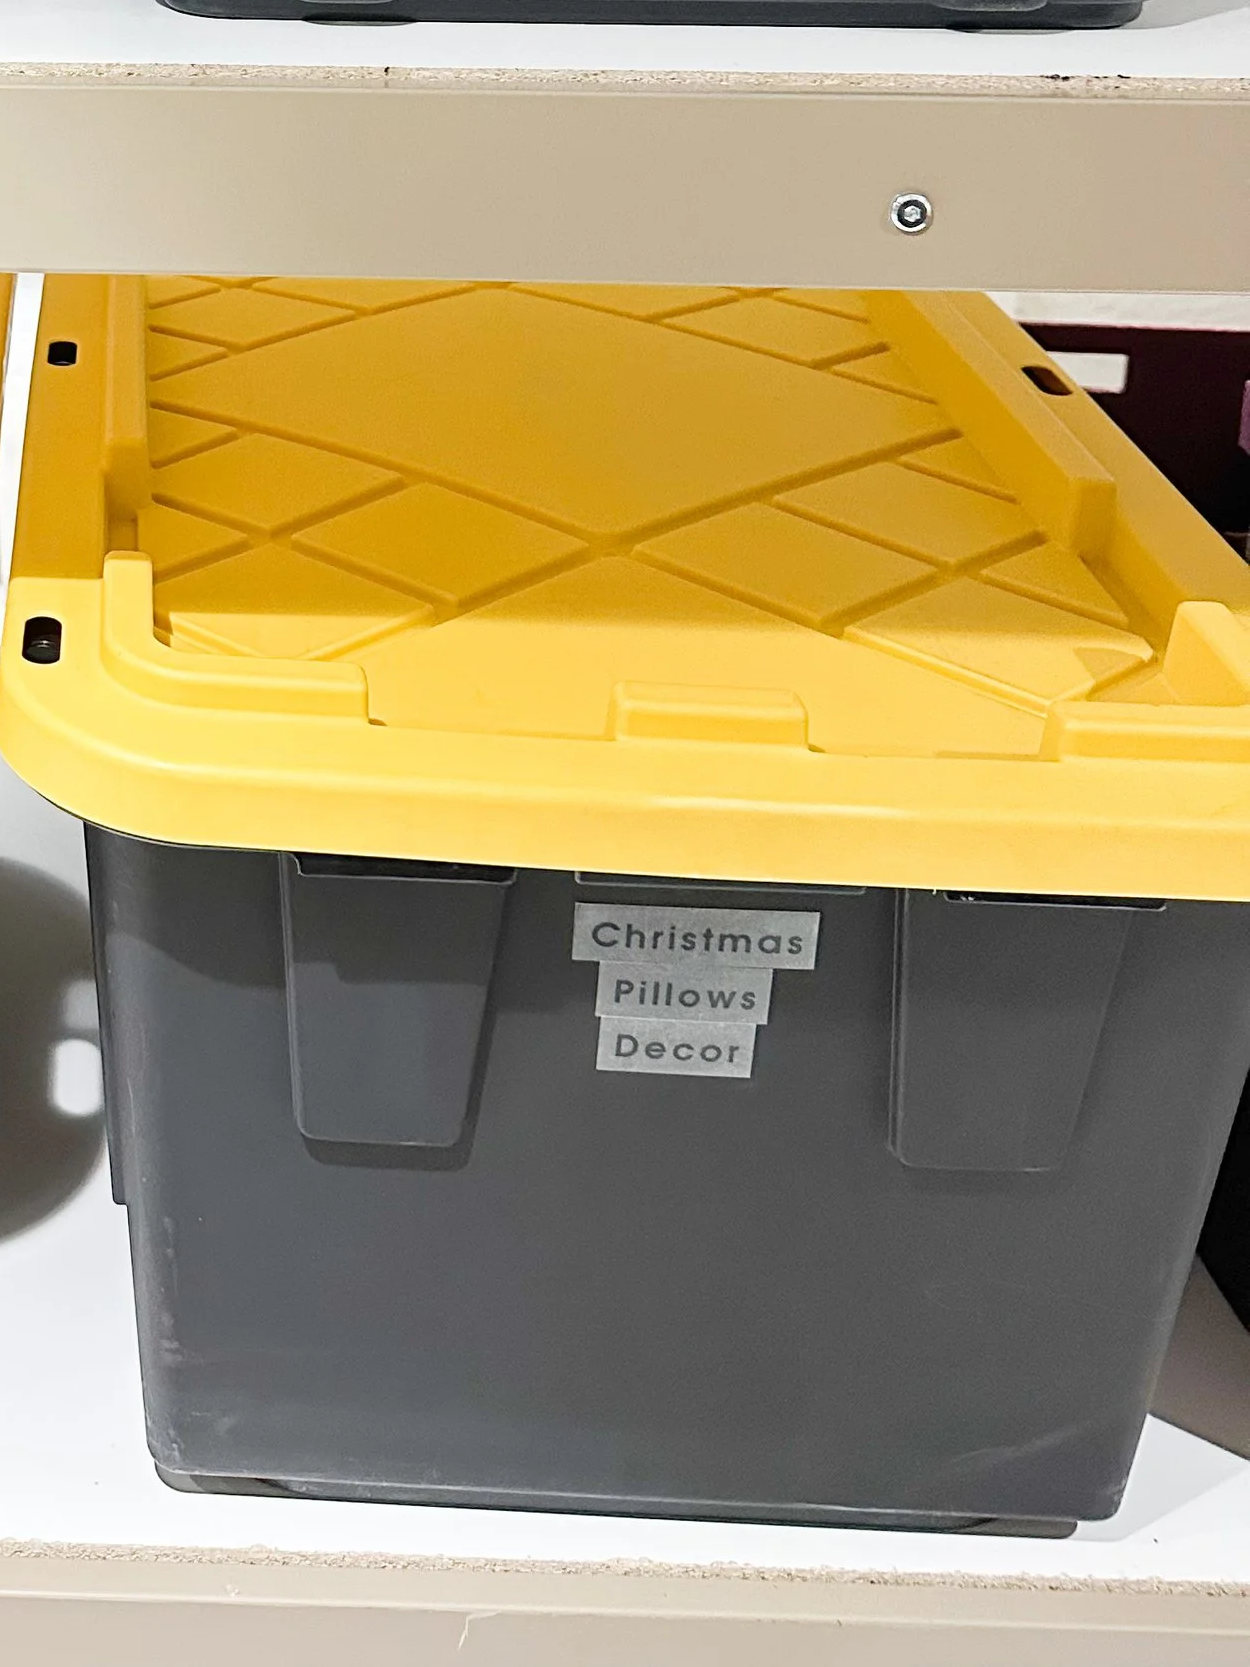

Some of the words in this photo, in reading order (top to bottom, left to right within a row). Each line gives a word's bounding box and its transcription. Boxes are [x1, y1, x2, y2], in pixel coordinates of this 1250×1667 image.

[591, 921, 804, 955] Christmas
[613, 978, 757, 1011] Pillows
[614, 1033, 740, 1063] Decor
